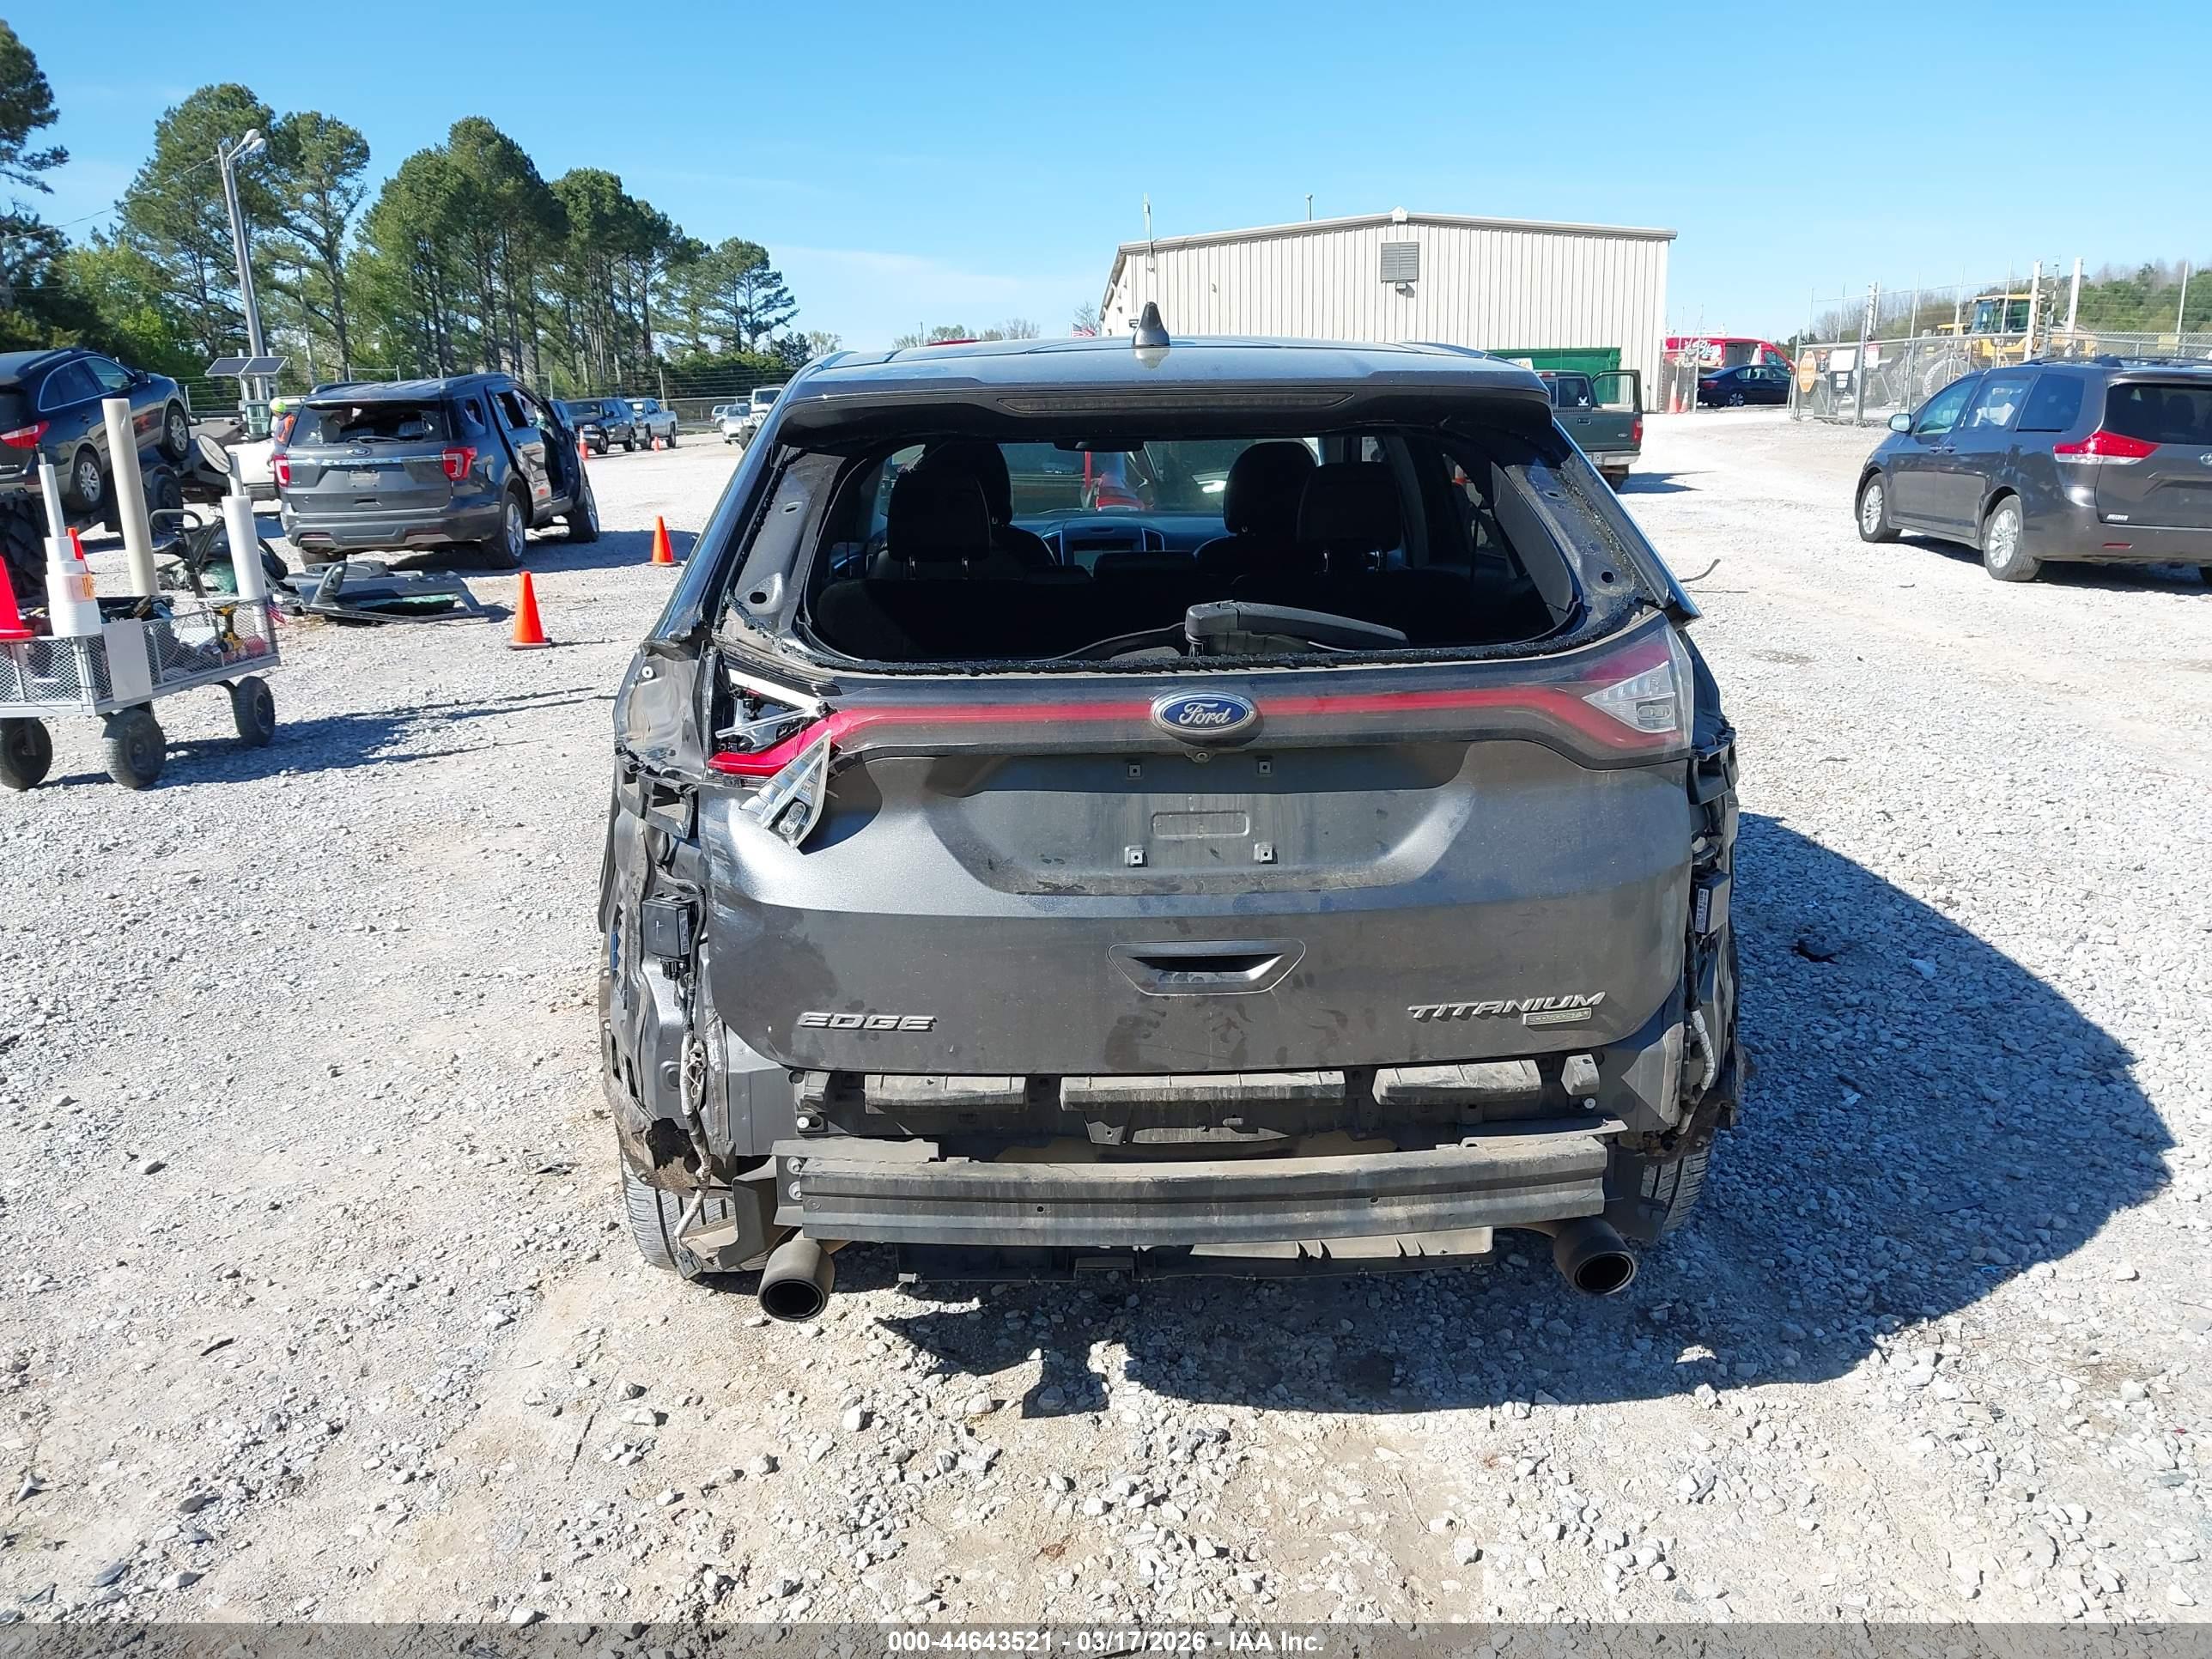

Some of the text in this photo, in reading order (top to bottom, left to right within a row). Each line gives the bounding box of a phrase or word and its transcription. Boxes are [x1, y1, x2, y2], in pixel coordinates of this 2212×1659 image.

[1179, 702, 1231, 724] Ford
[1407, 991, 1607, 1018] TITANIUM
[797, 1012, 936, 1032] EDGE
